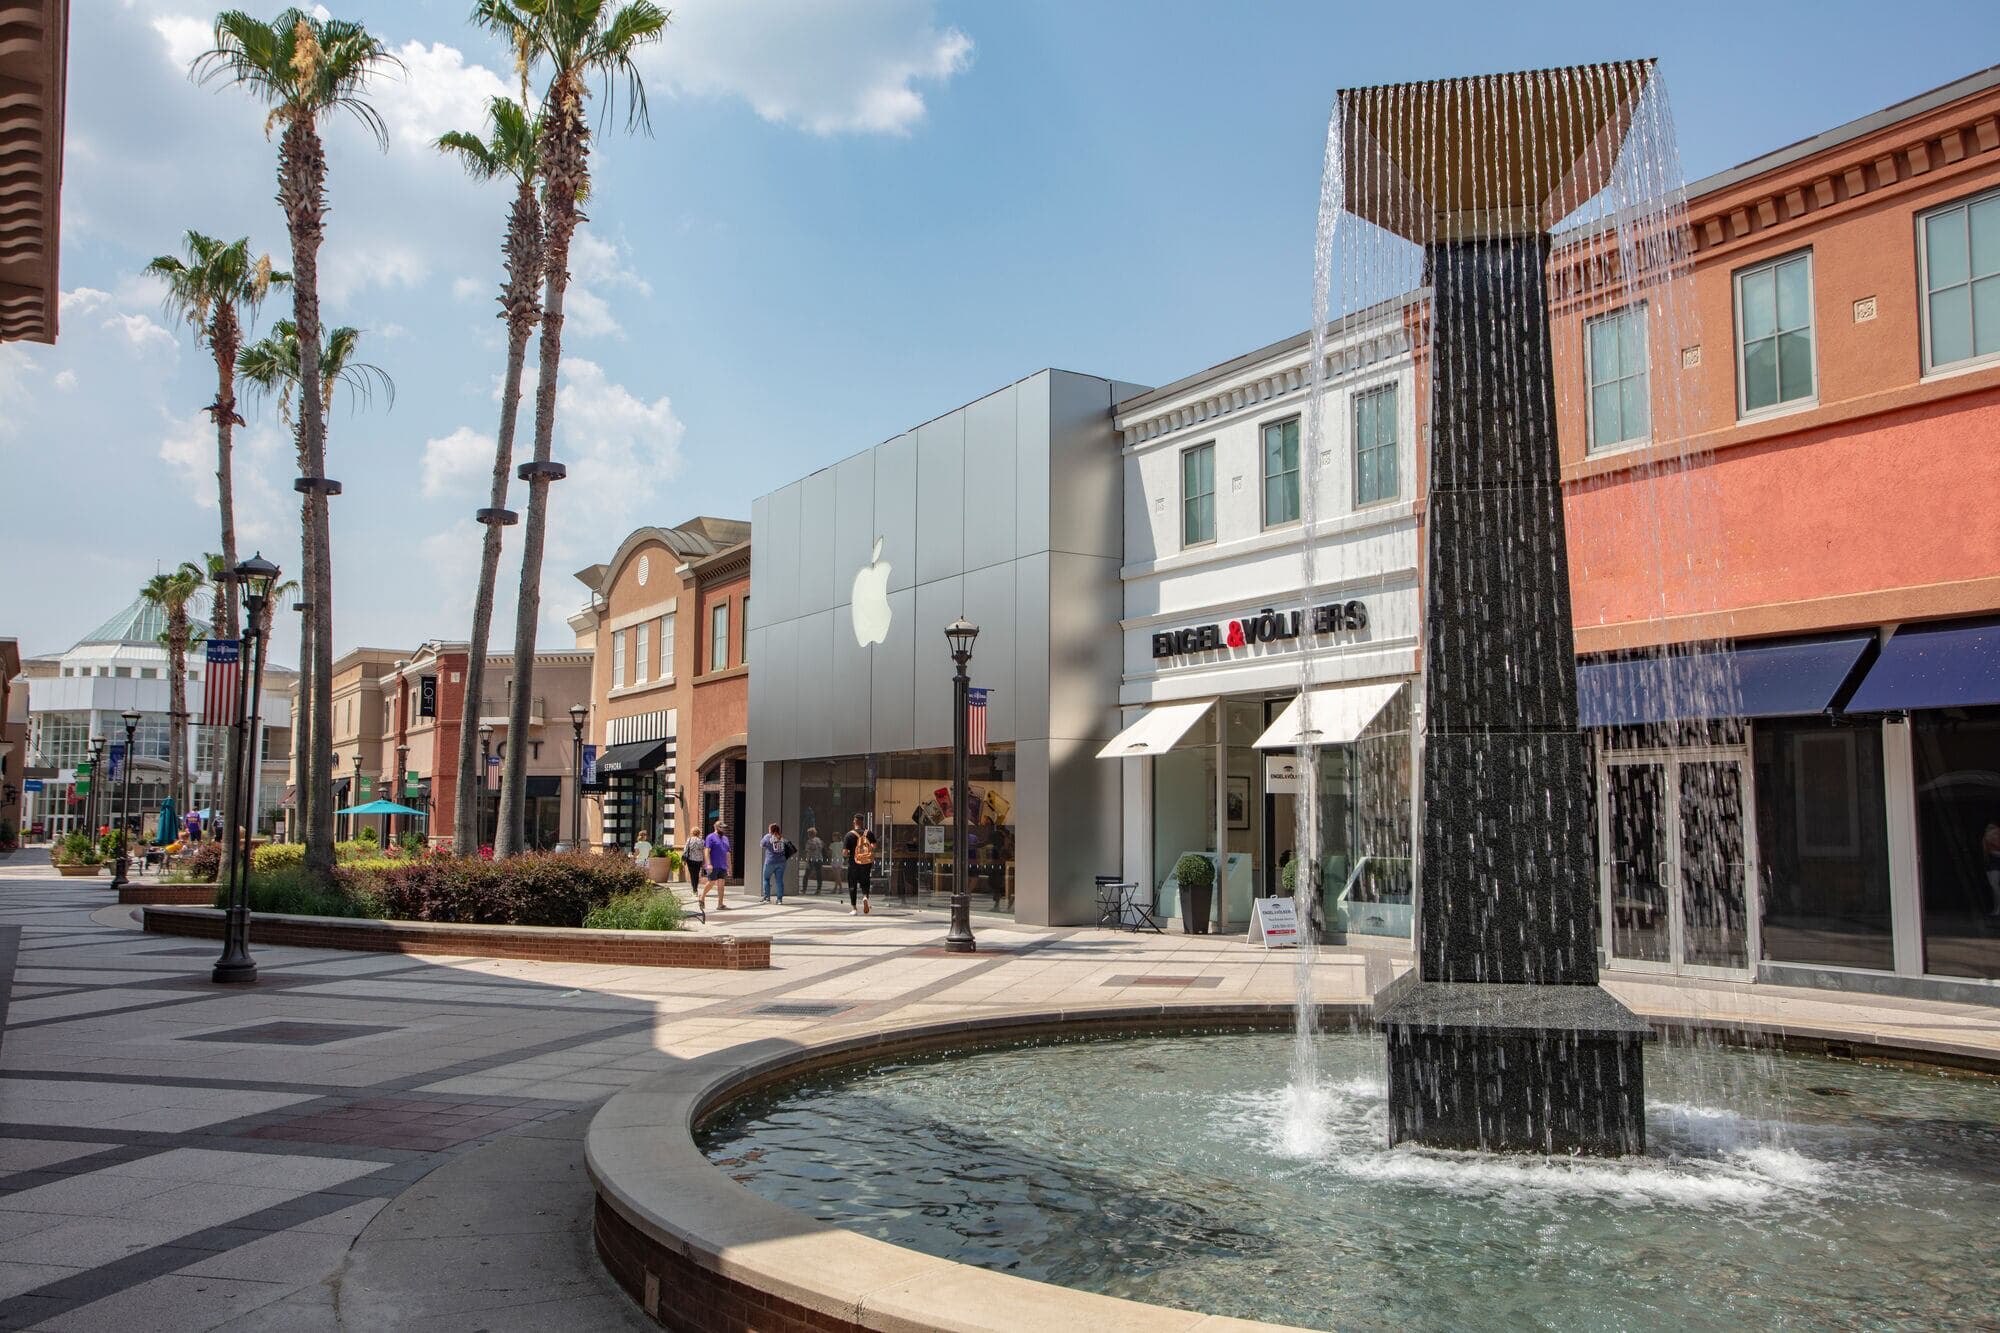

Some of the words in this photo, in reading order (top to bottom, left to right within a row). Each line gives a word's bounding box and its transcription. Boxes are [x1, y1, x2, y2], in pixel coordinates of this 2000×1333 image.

[1152, 624, 1227, 658] ENGEL
[1226, 620, 1245, 648] &
[423, 680, 434, 712] LOFT
[604, 762, 622, 772] SEPHORA
